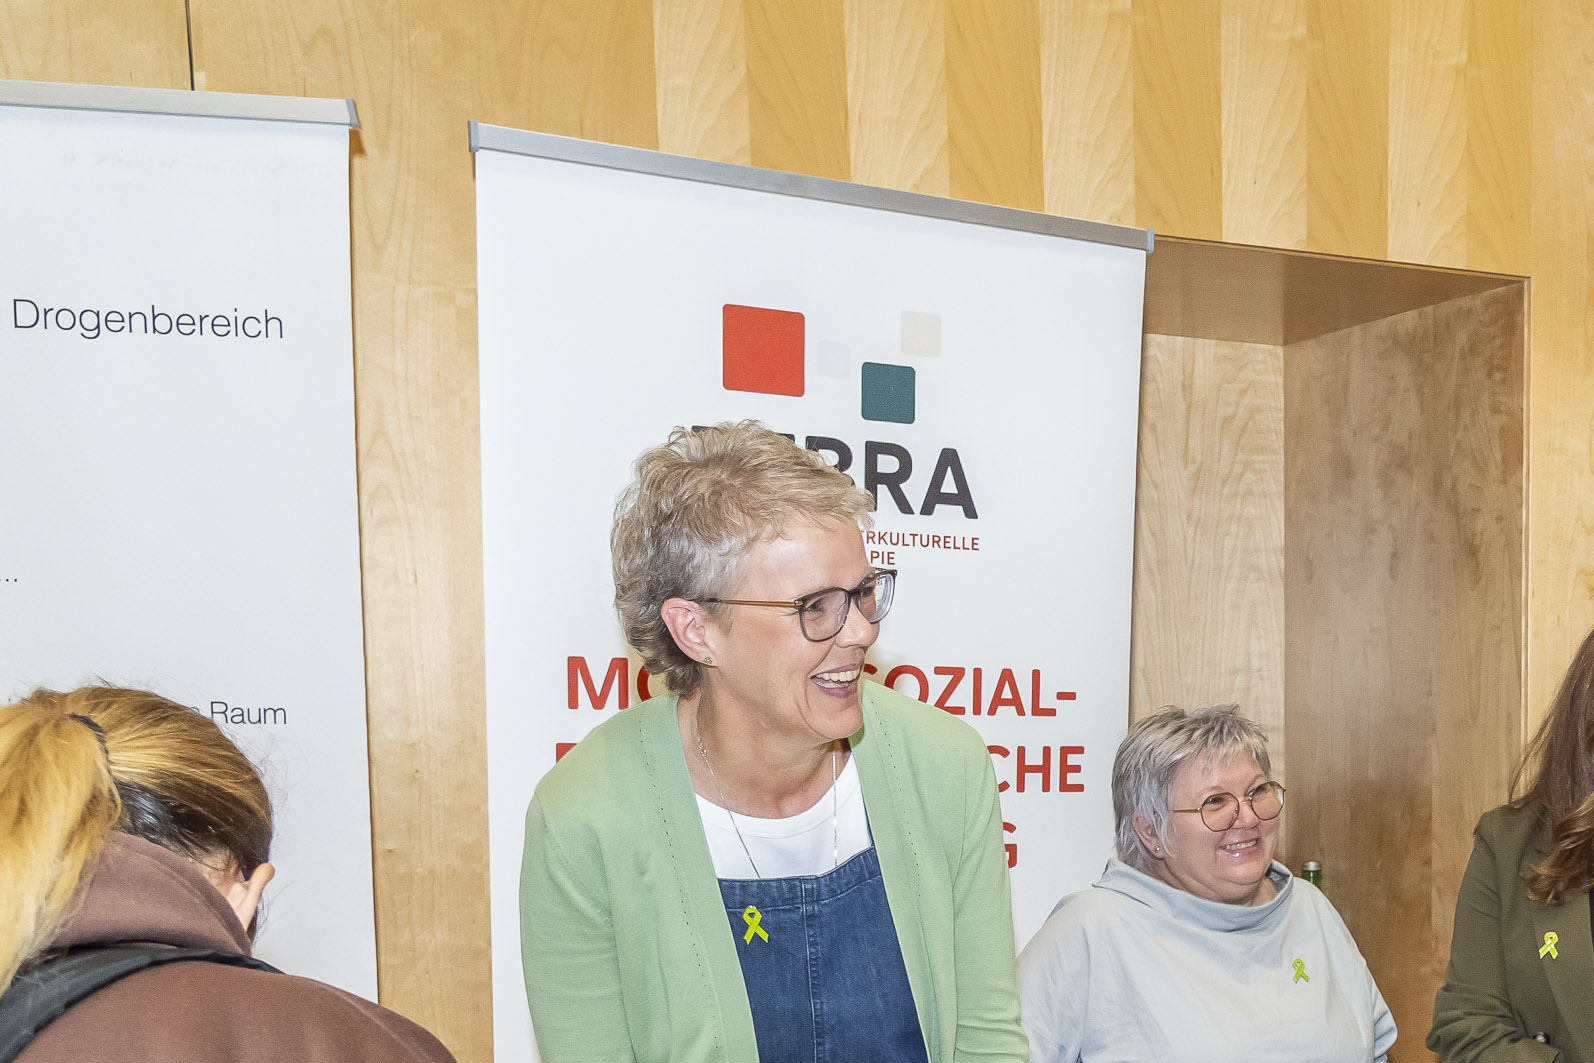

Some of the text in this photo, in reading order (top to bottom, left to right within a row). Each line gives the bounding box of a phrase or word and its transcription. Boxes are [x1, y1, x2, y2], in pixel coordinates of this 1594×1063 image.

[13, 298, 284, 339] Drogenbereich
[861, 530, 980, 551] RKULTURELLE
[210, 701, 287, 726] Raum
